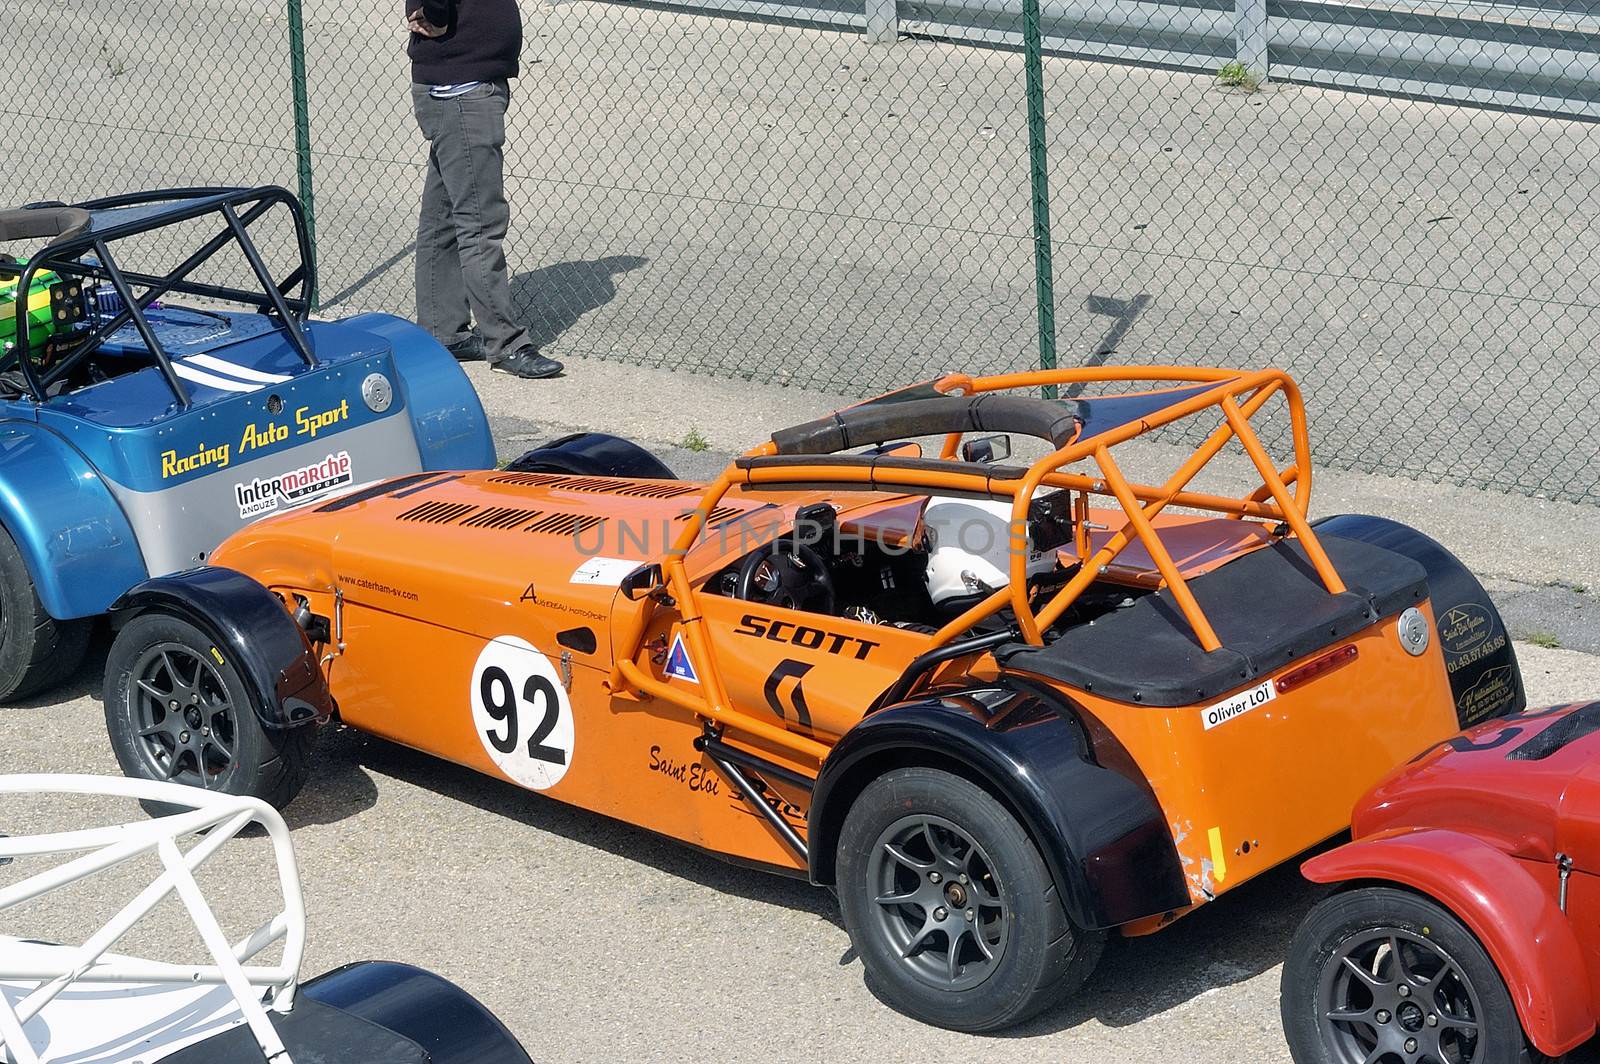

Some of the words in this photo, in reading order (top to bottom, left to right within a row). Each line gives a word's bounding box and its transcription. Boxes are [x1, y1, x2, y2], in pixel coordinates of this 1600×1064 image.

[161, 437, 230, 479] Racing
[239, 424, 289, 454] Auto
[296, 399, 349, 437] Sport
[299, 478, 340, 496] SUPER
[242, 499, 276, 515] ANDUZE
[338, 574, 419, 601] www.caterham-sv.com
[733, 614, 880, 660] SCOTT
[480, 665, 566, 766] 92
[1208, 703, 1247, 725] Olivier
[649, 745, 687, 783] Saint
[689, 763, 720, 796] Eloi
